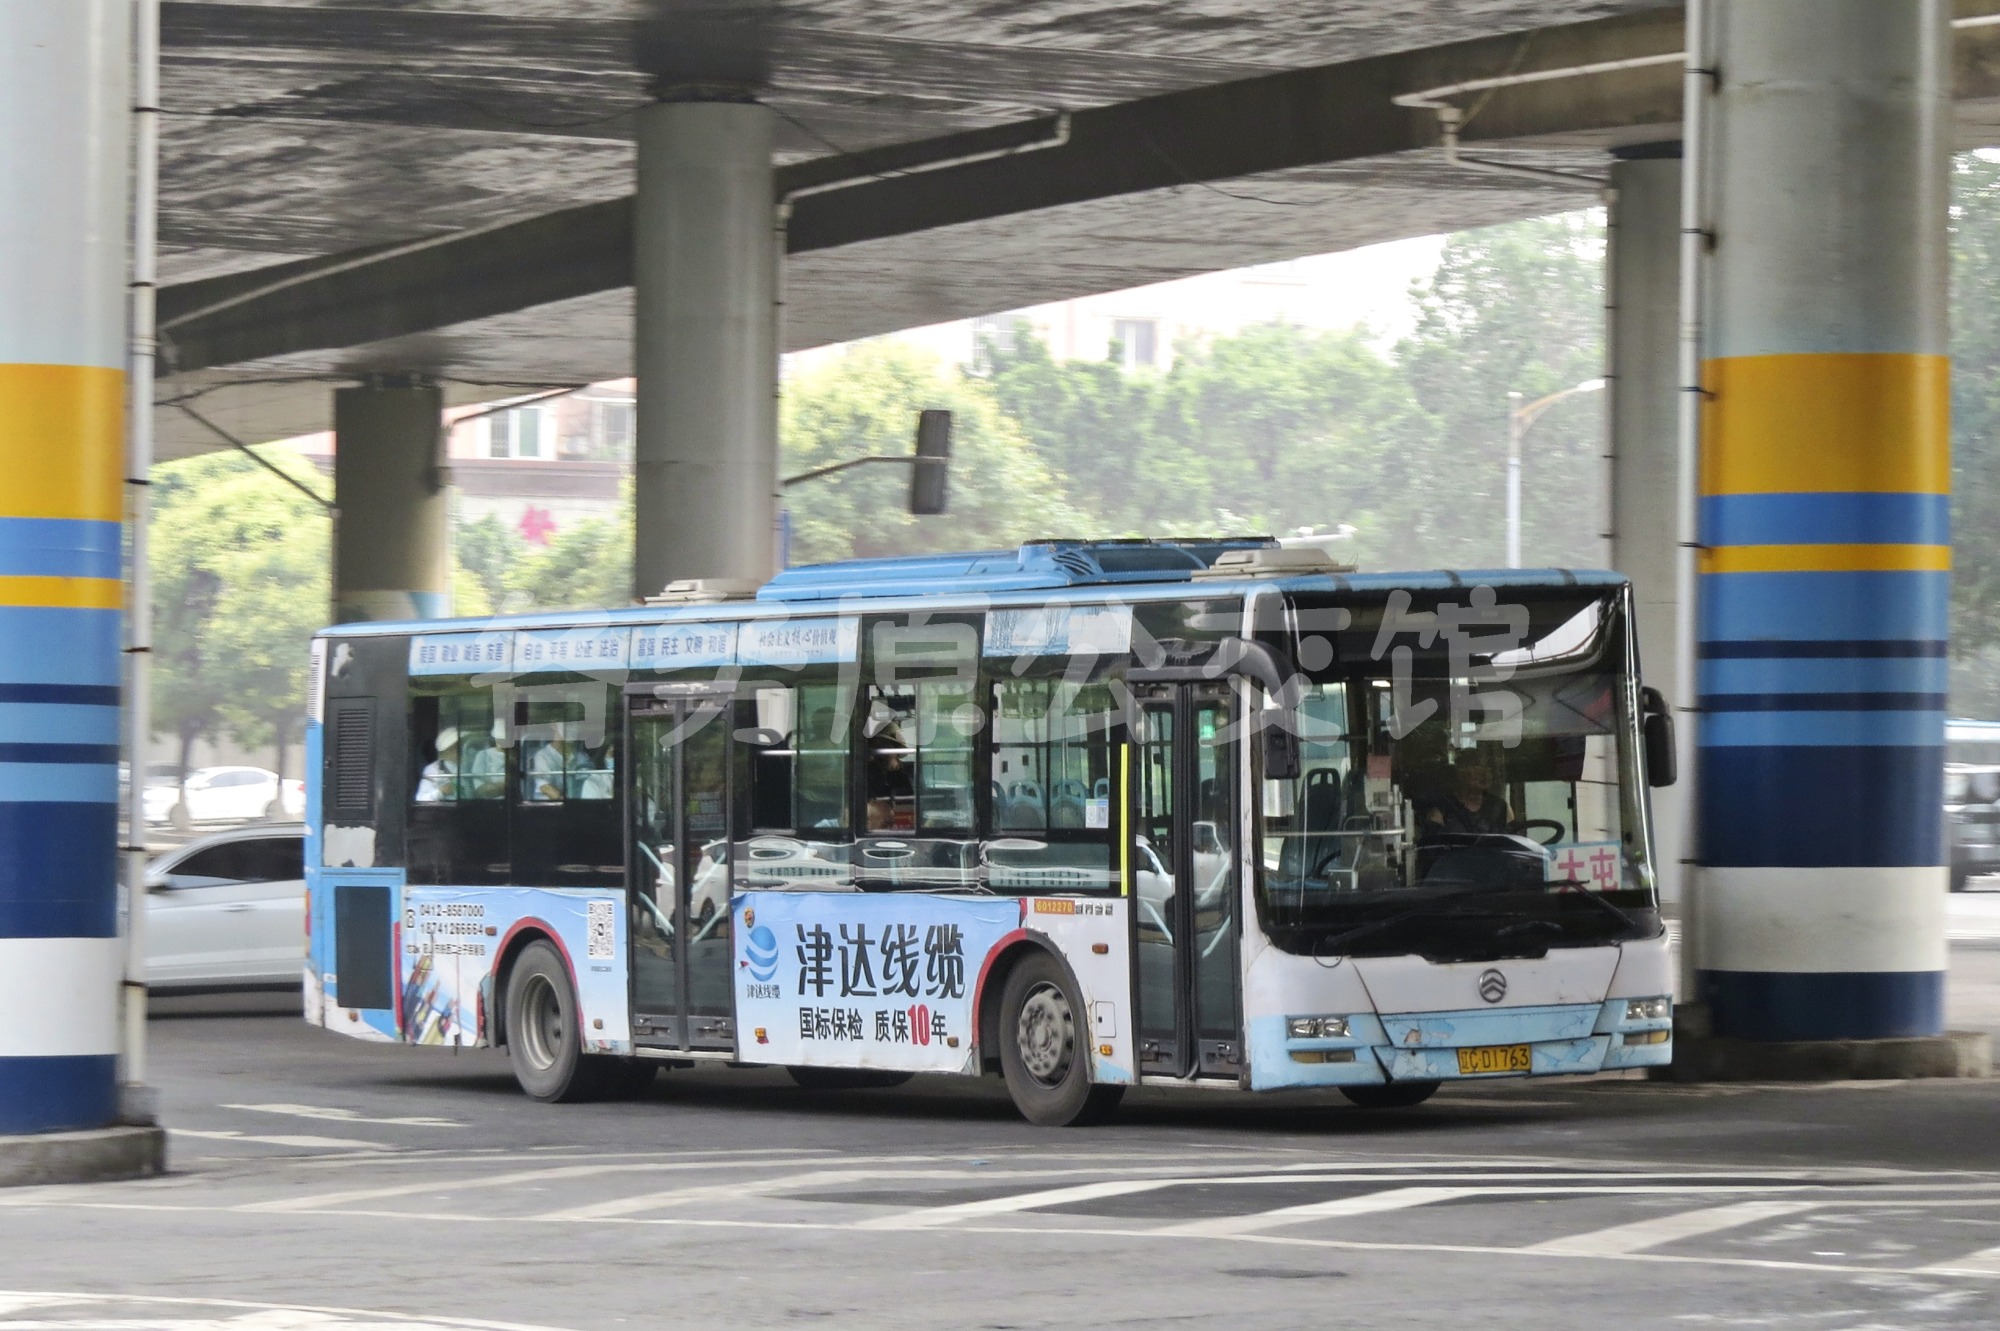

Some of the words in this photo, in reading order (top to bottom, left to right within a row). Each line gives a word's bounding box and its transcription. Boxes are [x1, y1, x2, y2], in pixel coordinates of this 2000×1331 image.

[661, 637, 680, 656] 民主
[685, 636, 703, 655] 文明
[1558, 847, 1618, 894] 大屯
[796, 923, 966, 999] 津达线缆
[747, 984, 780, 999] 津达线缆
[799, 1006, 864, 1042] 国标保检
[875, 1003, 948, 1046] 质保10年
